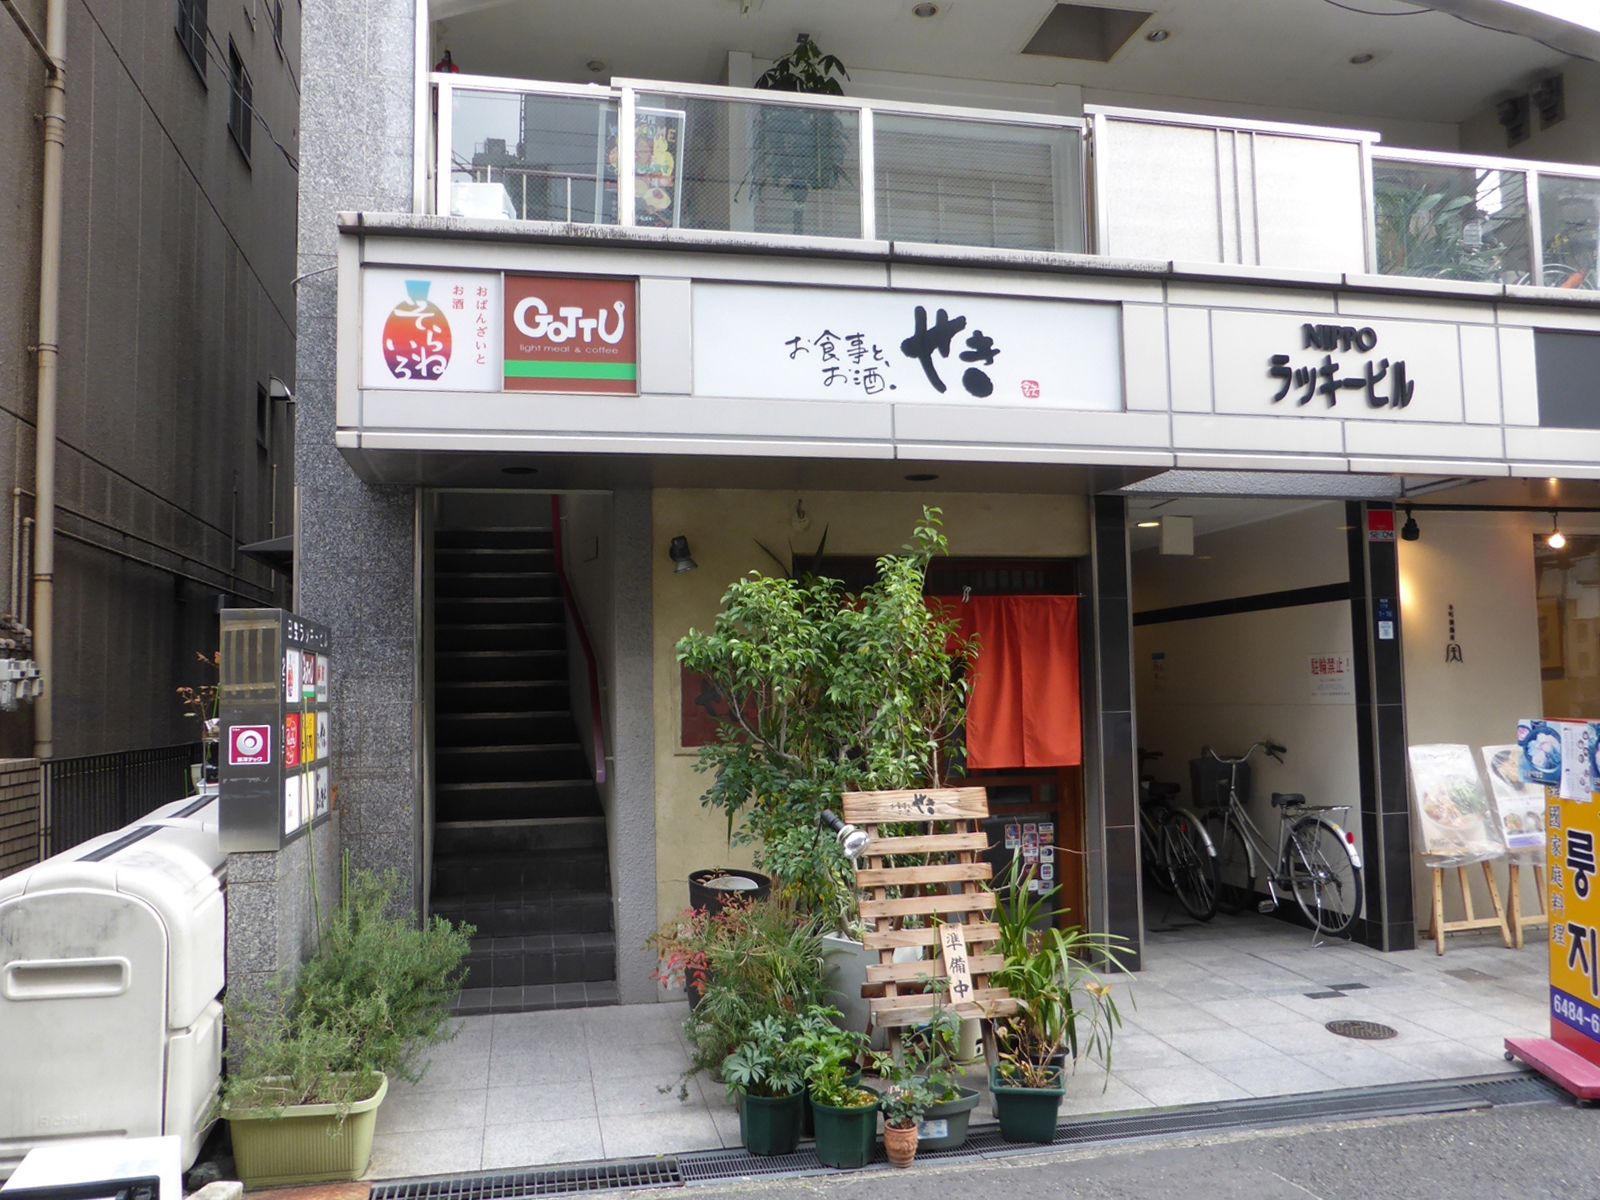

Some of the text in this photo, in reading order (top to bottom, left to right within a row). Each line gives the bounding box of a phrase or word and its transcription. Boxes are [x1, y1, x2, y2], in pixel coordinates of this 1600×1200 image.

[452, 284, 465, 310] お酒
[475, 286, 488, 365] おばんざいと
[519, 344, 541, 354] light
[543, 345, 570, 353] meal
[585, 346, 619, 354] coffee
[900, 305, 1001, 398] やき
[1301, 323, 1378, 352] NIPPO
[1269, 354, 1415, 409] ラッキービル
[946, 932, 970, 999] 準備中
